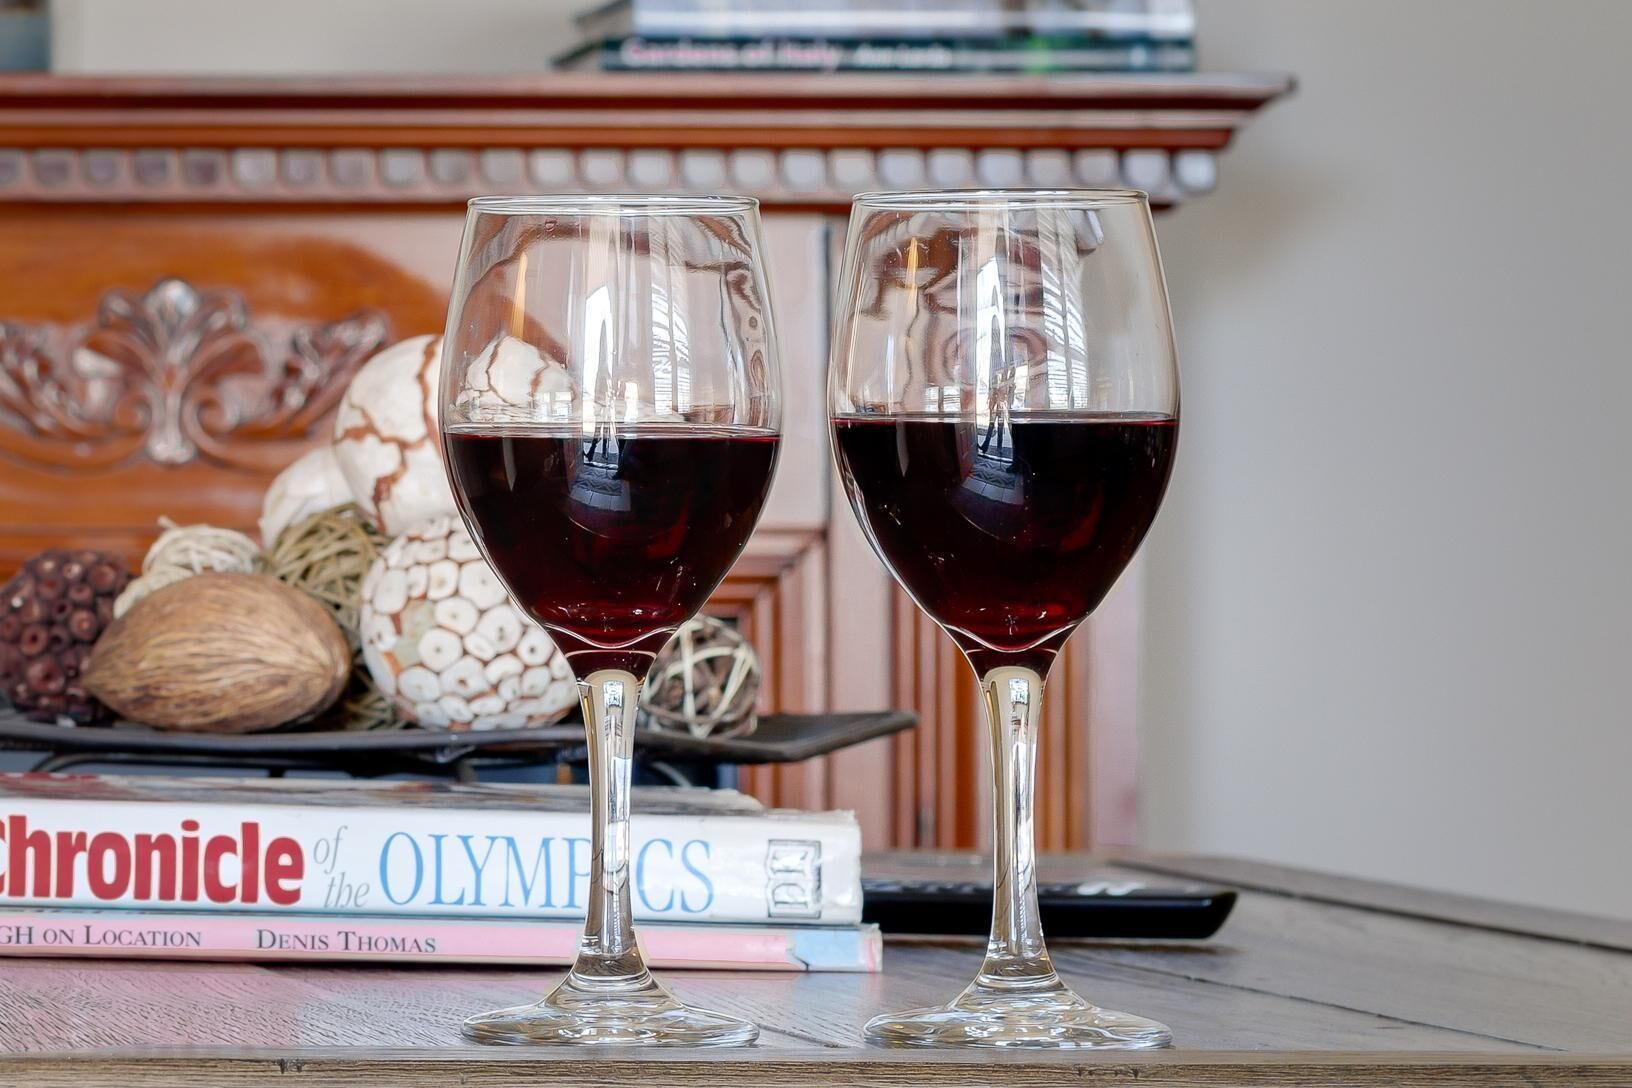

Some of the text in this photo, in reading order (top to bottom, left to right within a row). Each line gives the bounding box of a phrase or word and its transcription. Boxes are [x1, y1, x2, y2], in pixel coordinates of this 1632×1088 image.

[313, 824, 349, 874] of
[378, 830, 715, 915] OLYMPCS
[323, 872, 371, 910] the
